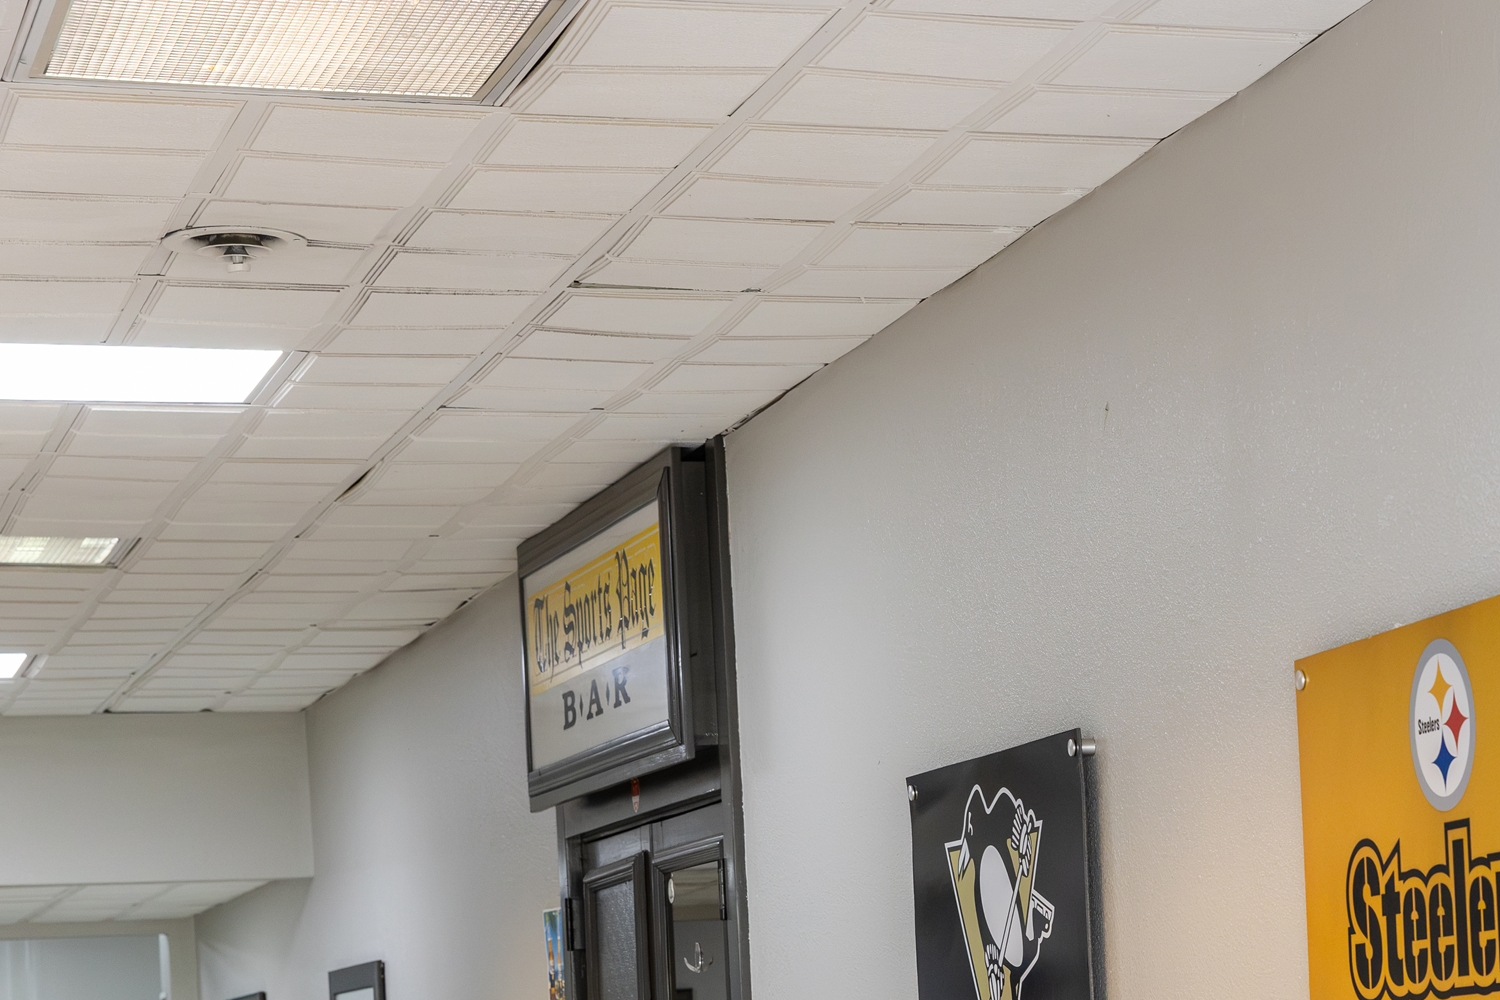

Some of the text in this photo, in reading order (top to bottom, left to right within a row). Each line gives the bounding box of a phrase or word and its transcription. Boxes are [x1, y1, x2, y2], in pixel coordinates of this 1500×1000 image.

[534, 548, 657, 683] The Sports Page
[1418, 716, 1440, 735] Steelers
